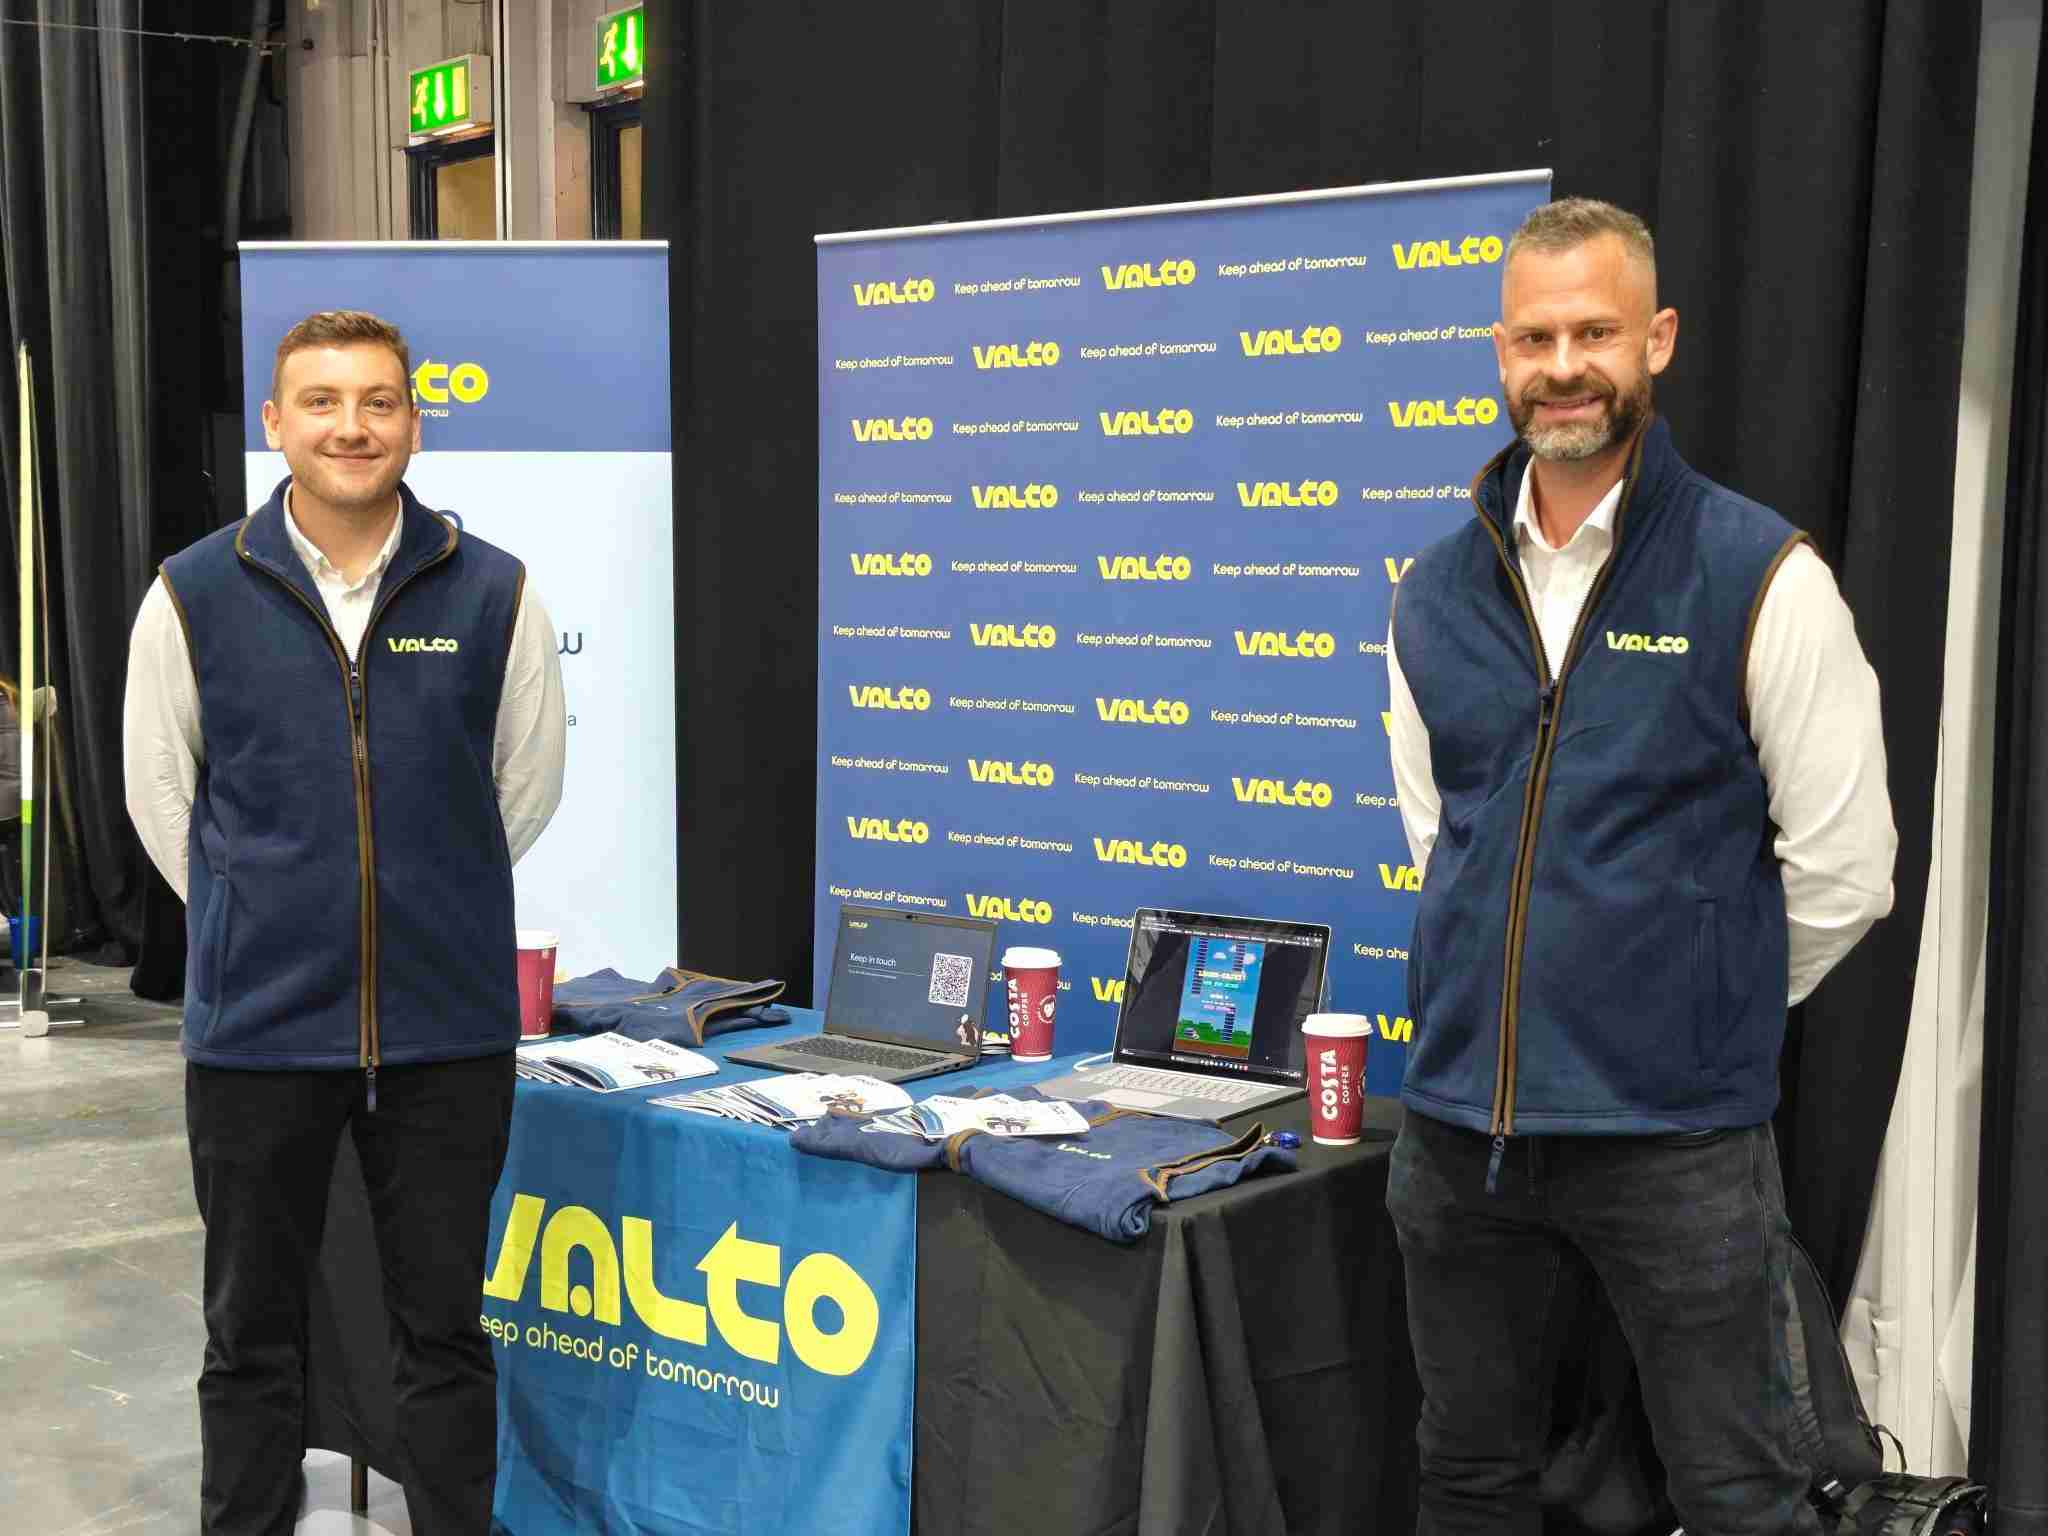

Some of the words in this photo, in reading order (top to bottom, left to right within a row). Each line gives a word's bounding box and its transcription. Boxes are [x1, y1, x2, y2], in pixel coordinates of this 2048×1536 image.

[1218, 265, 1247, 277] Keep
[1249, 259, 1287, 273] ahead
[1287, 257, 1303, 271] of
[1304, 256, 1367, 269] tomorrow
[954, 284, 979, 296] Keep
[980, 280, 1013, 292] ahead
[1013, 278, 1027, 290] of
[1027, 277, 1081, 289] tomorrow
[1365, 332, 1396, 346] Keep
[1398, 328, 1438, 342] ahead
[1439, 326, 1456, 339] of
[1458, 327, 1495, 338] tomo
[1080, 348, 1107, 360] Keep
[1108, 344, 1143, 357] ahead
[1144, 342, 1159, 355] of
[1159, 343, 1217, 354] tomorrow
[835, 360, 859, 371] Keep
[859, 357, 890, 368] ahead
[890, 356, 903, 367] of
[903, 356, 954, 366] tomorrow
[952, 424, 978, 436] Keep
[978, 422, 1011, 433] ahead
[1011, 421, 1026, 432] of
[1026, 421, 1080, 432] tomorrow
[1215, 416, 1244, 428] Keep
[1246, 412, 1284, 425] ahead
[1284, 412, 1300, 424] of
[1301, 413, 1364, 424] tomorrow
[834, 493, 858, 504] Keep
[858, 492, 889, 504] ahead
[889, 492, 902, 504] of
[902, 495, 953, 504] tomorrow
[1078, 491, 1105, 503] Keep
[1106, 490, 1141, 502] ahead
[1142, 490, 1157, 502] of
[1157, 490, 1215, 502] tomorrow
[1362, 488, 1393, 502] Keep
[1394, 486, 1434, 499] ahead
[1435, 486, 1451, 498] of
[951, 561, 976, 573] Keep
[977, 561, 1010, 572] ahead
[1010, 561, 1024, 572] of
[1024, 560, 1078, 573] tomorrow
[1213, 563, 1242, 578] Keep
[1243, 563, 1281, 575] ahead
[1281, 563, 1297, 575] of
[1298, 564, 1360, 576] tomorrow
[833, 625, 857, 638] Keep
[857, 625, 888, 636] ahead
[888, 626, 901, 637] of
[901, 629, 952, 639] tomorrow
[1076, 632, 1103, 646] Keep
[1104, 633, 1139, 645] ahead
[1139, 634, 1154, 646] of
[1154, 636, 1212, 648] tomorrow
[949, 697, 974, 710] Keep
[975, 698, 1008, 709] ahead
[1008, 700, 1022, 710] of
[1022, 702, 1076, 713] tomorrow
[1210, 710, 1239, 724] Keep
[1240, 712, 1278, 724] ahead
[1278, 713, 1294, 724] of
[1295, 714, 1357, 728] tomorrow
[831, 756, 855, 768] Keep
[855, 757, 886, 769] ahead
[886, 760, 899, 769] of
[899, 760, 949, 773] tomorrow
[1074, 773, 1101, 787] Keep
[1102, 775, 1137, 787] ahead
[1137, 777, 1152, 788] of
[1152, 778, 1210, 792] tomorrow
[1355, 793, 1385, 808] Keep
[947, 832, 972, 845] Keep
[973, 834, 1006, 846] ahead
[1006, 836, 1020, 848] of
[1020, 838, 1074, 852] tomorrow
[1208, 855, 1237, 870] Keep
[1238, 857, 1276, 871] ahead
[1276, 861, 1292, 872] of
[1293, 863, 1355, 878] tomorrow
[829, 885, 853, 899] Keep
[853, 888, 884, 900] ahead
[884, 891, 897, 901] of
[897, 892, 947, 907] tomorrow
[1072, 912, 1099, 928] Keep
[1099, 915, 1134, 930] ahead
[1353, 943, 1383, 959] Keep
[1386, 947, 1409, 960] ahe
[1008, 978, 1021, 1039] COSTA
[1320, 1050, 1339, 1120] COSTA
[479, 1314, 519, 1348] eep
[525, 1322, 604, 1363] ahead
[608, 1343, 640, 1370] of
[646, 1349, 780, 1409] tomorrow
